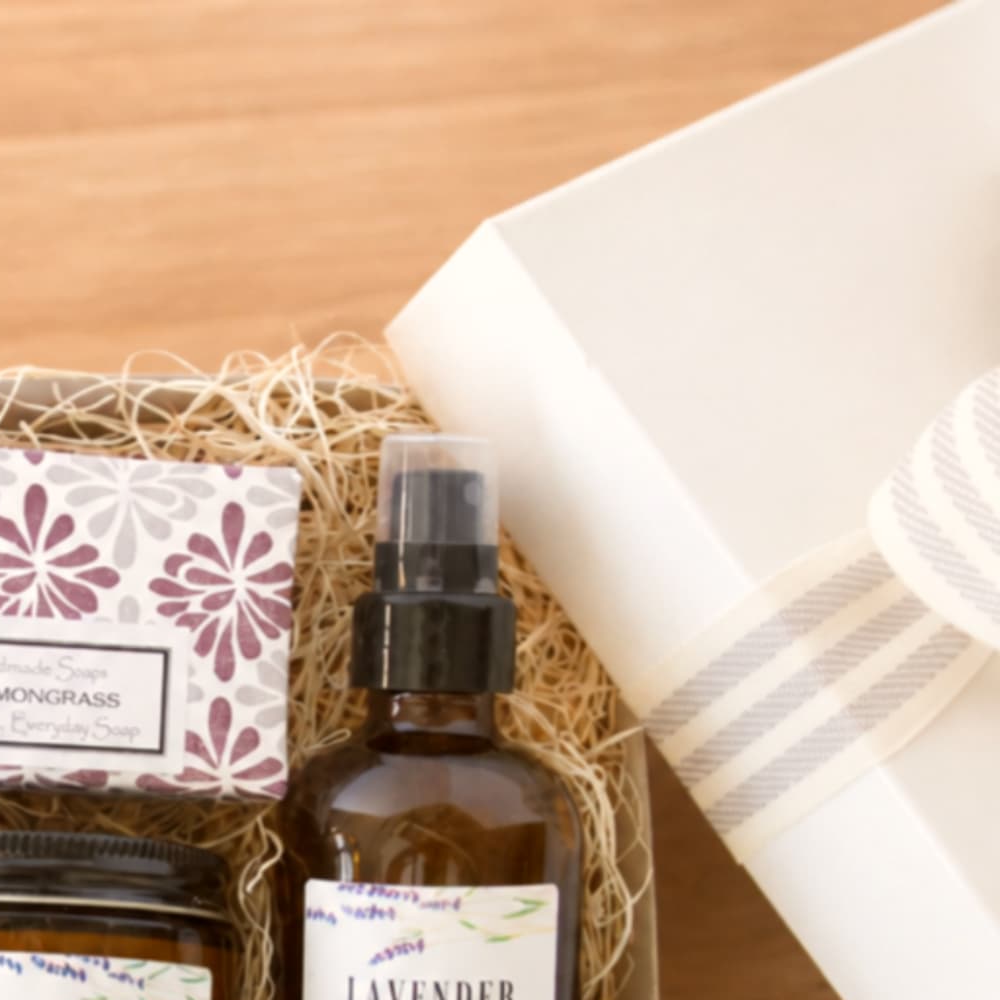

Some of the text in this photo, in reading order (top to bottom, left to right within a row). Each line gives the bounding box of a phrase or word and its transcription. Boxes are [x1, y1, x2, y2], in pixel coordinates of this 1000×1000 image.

[54, 656, 109, 683] Soaps
[10, 711, 90, 741] Everyday
[90, 716, 141, 743] Soap
